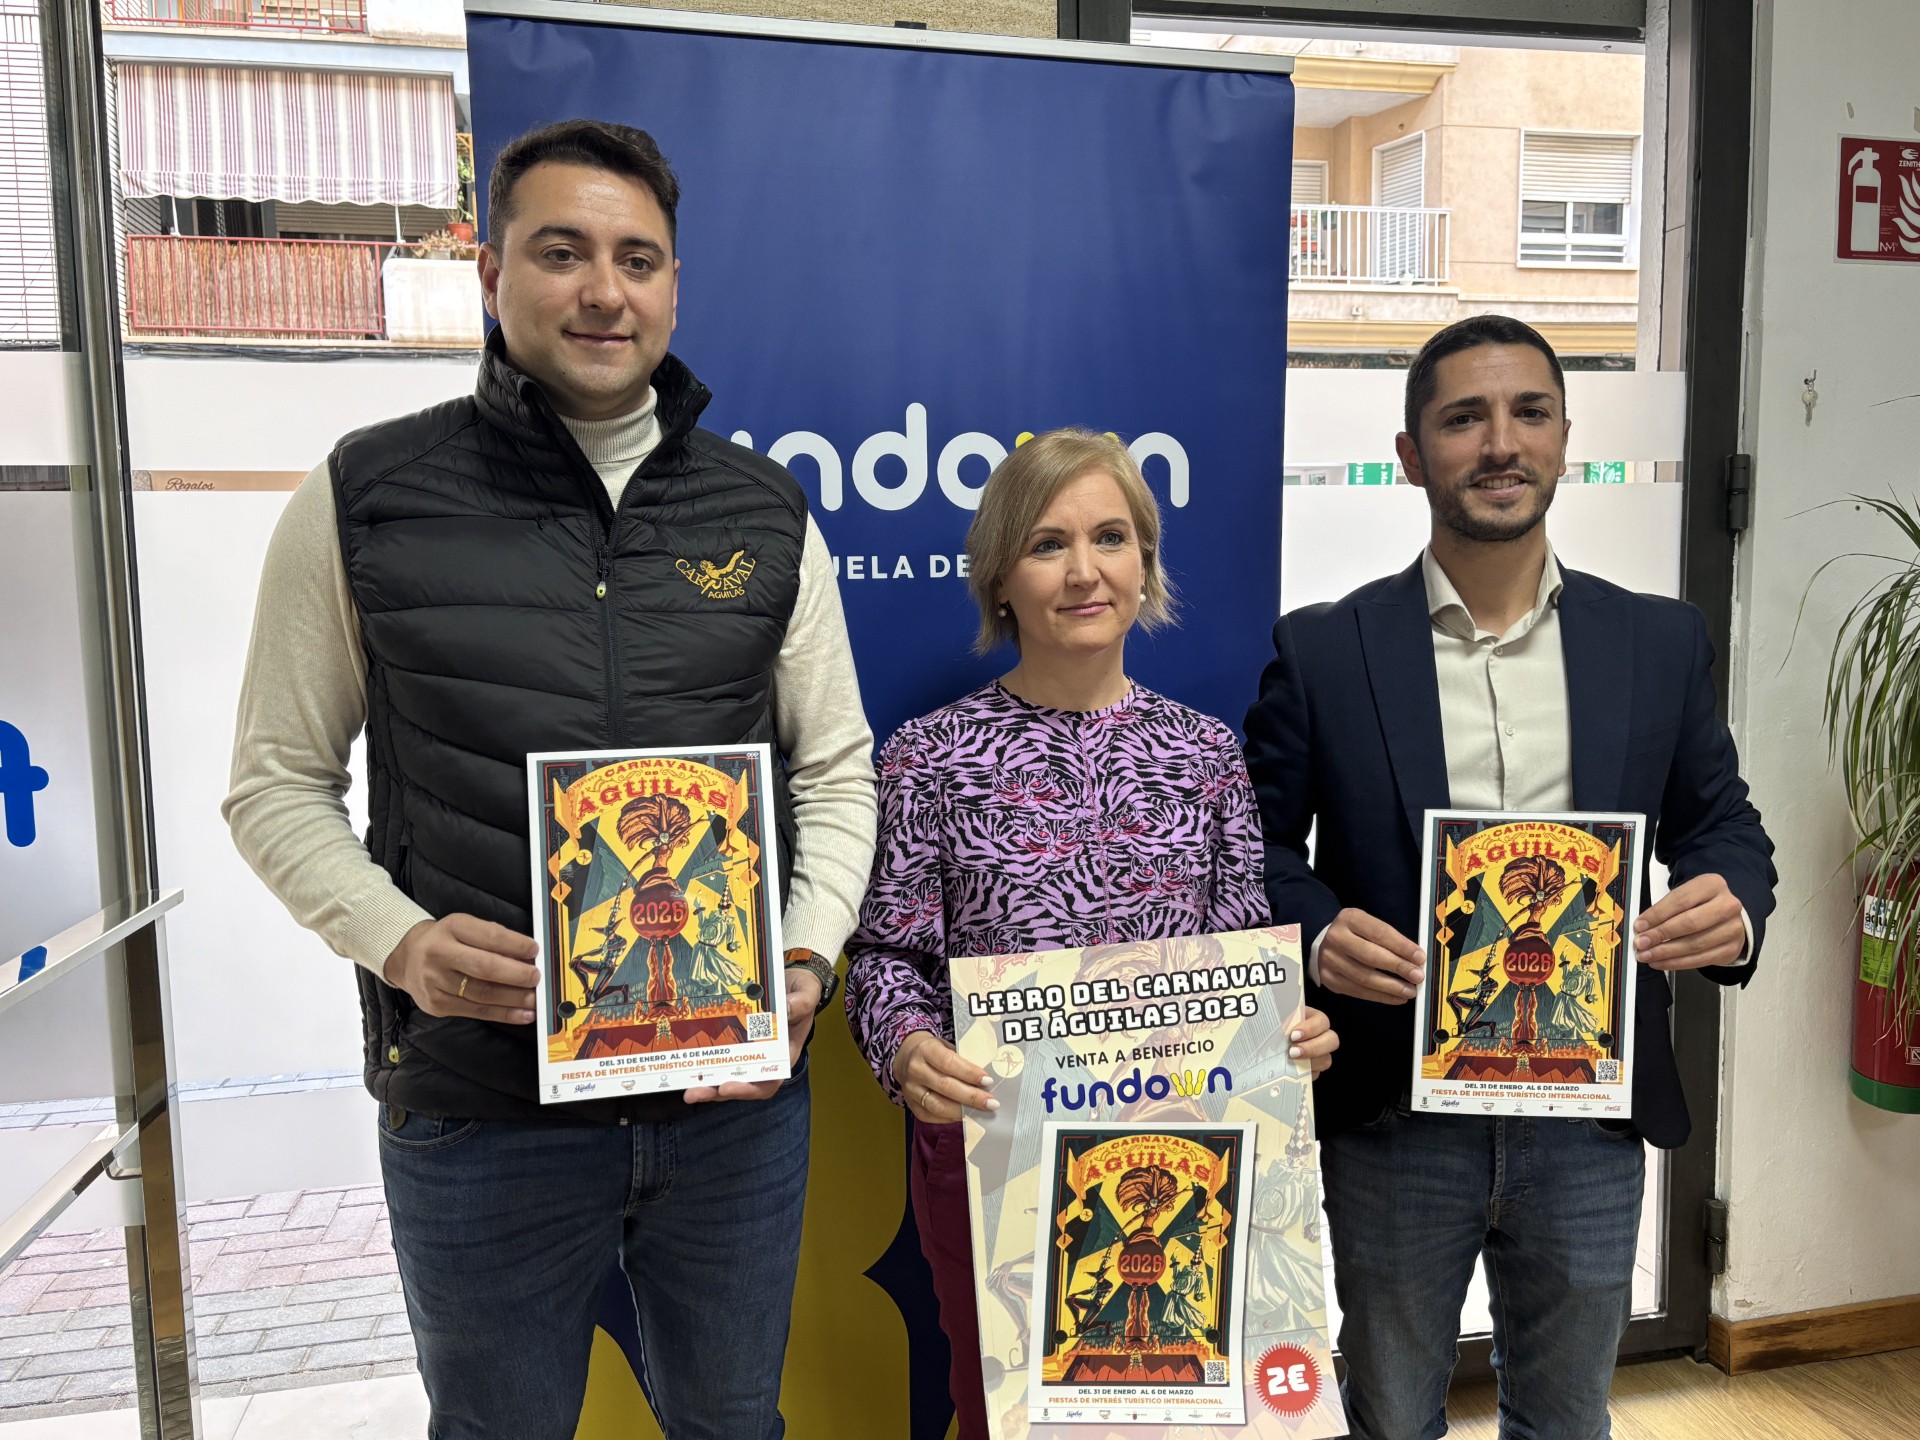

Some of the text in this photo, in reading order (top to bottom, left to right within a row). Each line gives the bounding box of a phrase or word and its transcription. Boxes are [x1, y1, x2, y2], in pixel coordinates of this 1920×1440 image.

[165, 477, 215, 491] Regalos
[604, 759, 699, 778] CARNAVAL
[1492, 822, 1577, 839] CARNAVAL
[632, 900, 684, 925] 2026
[1506, 951, 1551, 973] 2026
[968, 960, 1286, 1017] LIBRO DEL CARNAVAL
[1003, 994, 1258, 1044] DE ÁGUILAS 2026
[599, 1059, 616, 1067] DEL
[616, 1058, 625, 1066] 31
[626, 1056, 638, 1065] DE
[638, 1054, 667, 1064] ENERO
[701, 1047, 731, 1058] MARZO
[1055, 1038, 1215, 1070] VENTA A BENEFICIO
[561, 1071, 594, 1080] FIESTA
[609, 1065, 646, 1075] INTERÉS
[649, 1058, 694, 1071] TURÍSTICO
[696, 1052, 767, 1066] INTERNACIONAL
[1040, 1066, 1233, 1113] fundown
[1431, 1088, 1458, 1096] FIESTA
[1472, 1089, 1504, 1097] INTERÉS
[1548, 1092, 1611, 1100] INTERNACIONAL
[1110, 1135, 1190, 1150] CARNAVAL
[1120, 1253, 1163, 1273] 2026
[1266, 1363, 1310, 1396] 2€
[1092, 1396, 1122, 1404] INTERÉS
